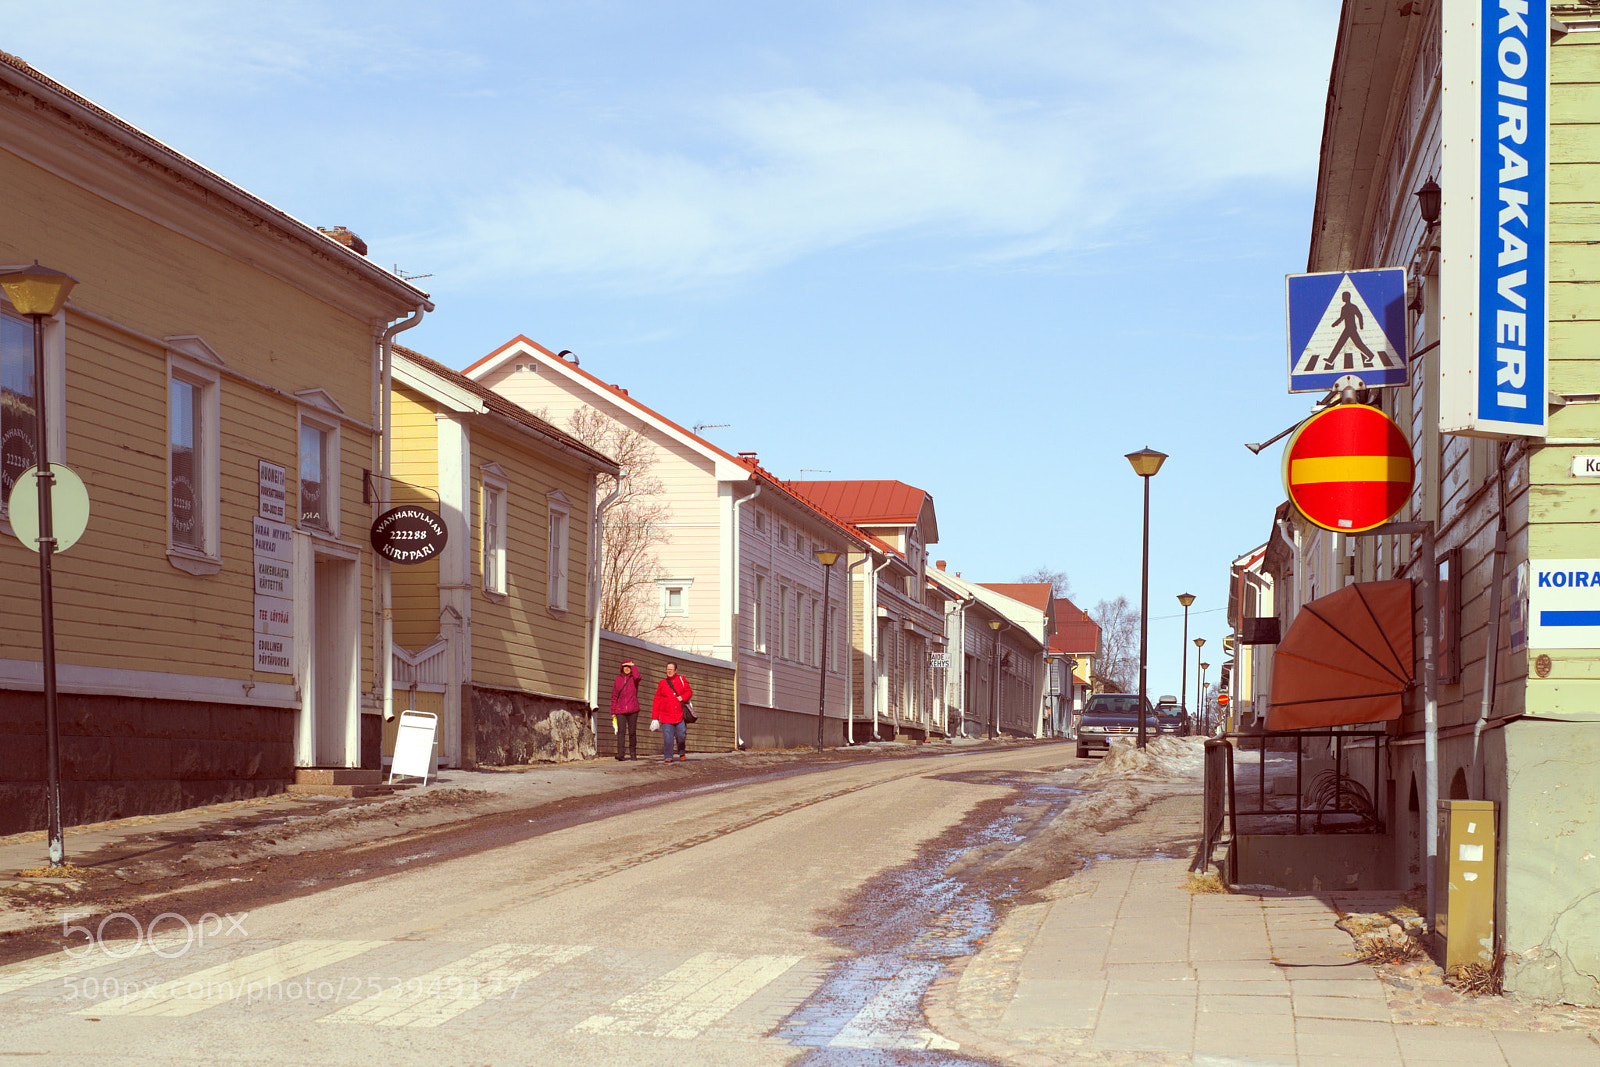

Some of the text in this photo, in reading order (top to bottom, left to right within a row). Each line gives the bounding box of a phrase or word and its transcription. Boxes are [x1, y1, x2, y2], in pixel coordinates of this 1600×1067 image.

[1497, 0, 1528, 408] KOIRAKAVERI
[255, 524, 270, 537] VARAA
[376, 510, 443, 536] WANHAKULMAN
[390, 530, 427, 540] 222288
[255, 538, 276, 553] PAIKKASI
[382, 543, 435, 560] KIRPPARI
[1538, 571, 1600, 588] KOIRA
[259, 609, 289, 624] TEE LÖYTÖJÄ
[258, 640, 283, 653] EDULLINEN
[258, 652, 290, 668] PÖYTÄVUOKRA
